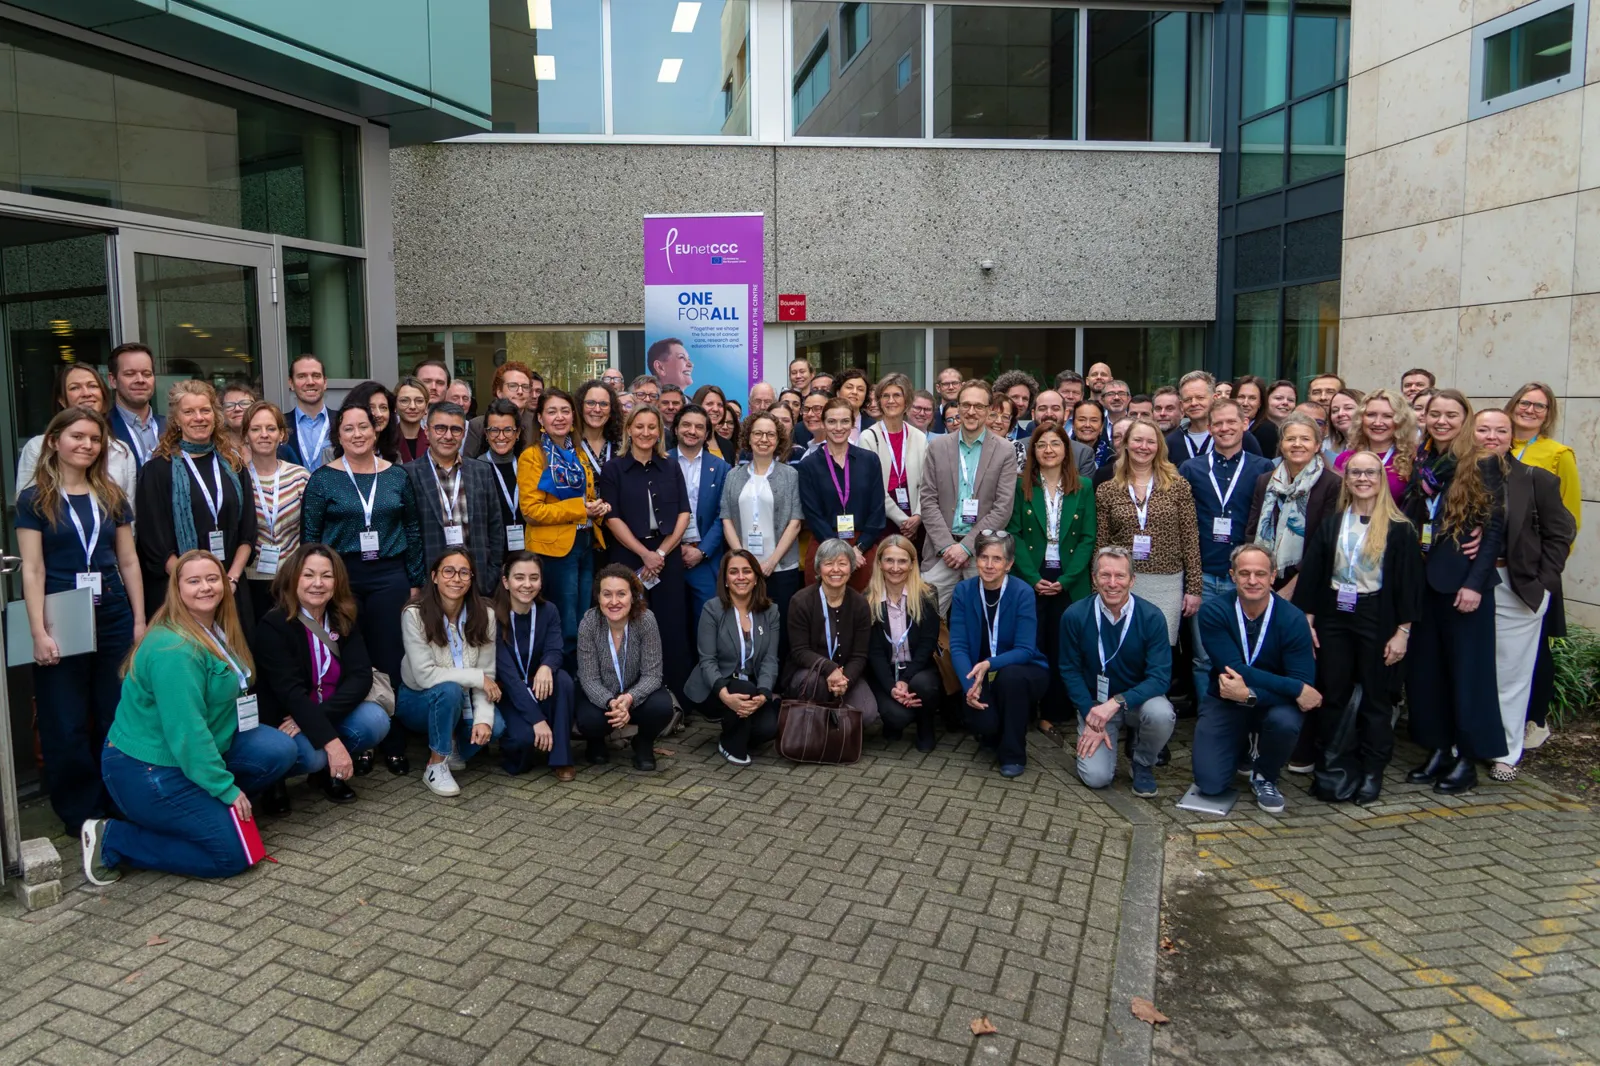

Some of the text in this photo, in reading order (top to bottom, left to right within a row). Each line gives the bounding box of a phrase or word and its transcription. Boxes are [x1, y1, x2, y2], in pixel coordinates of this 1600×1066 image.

[675, 243, 738, 254] EUnetCCC
[678, 292, 713, 305] ONE
[790, 308, 796, 316] C
